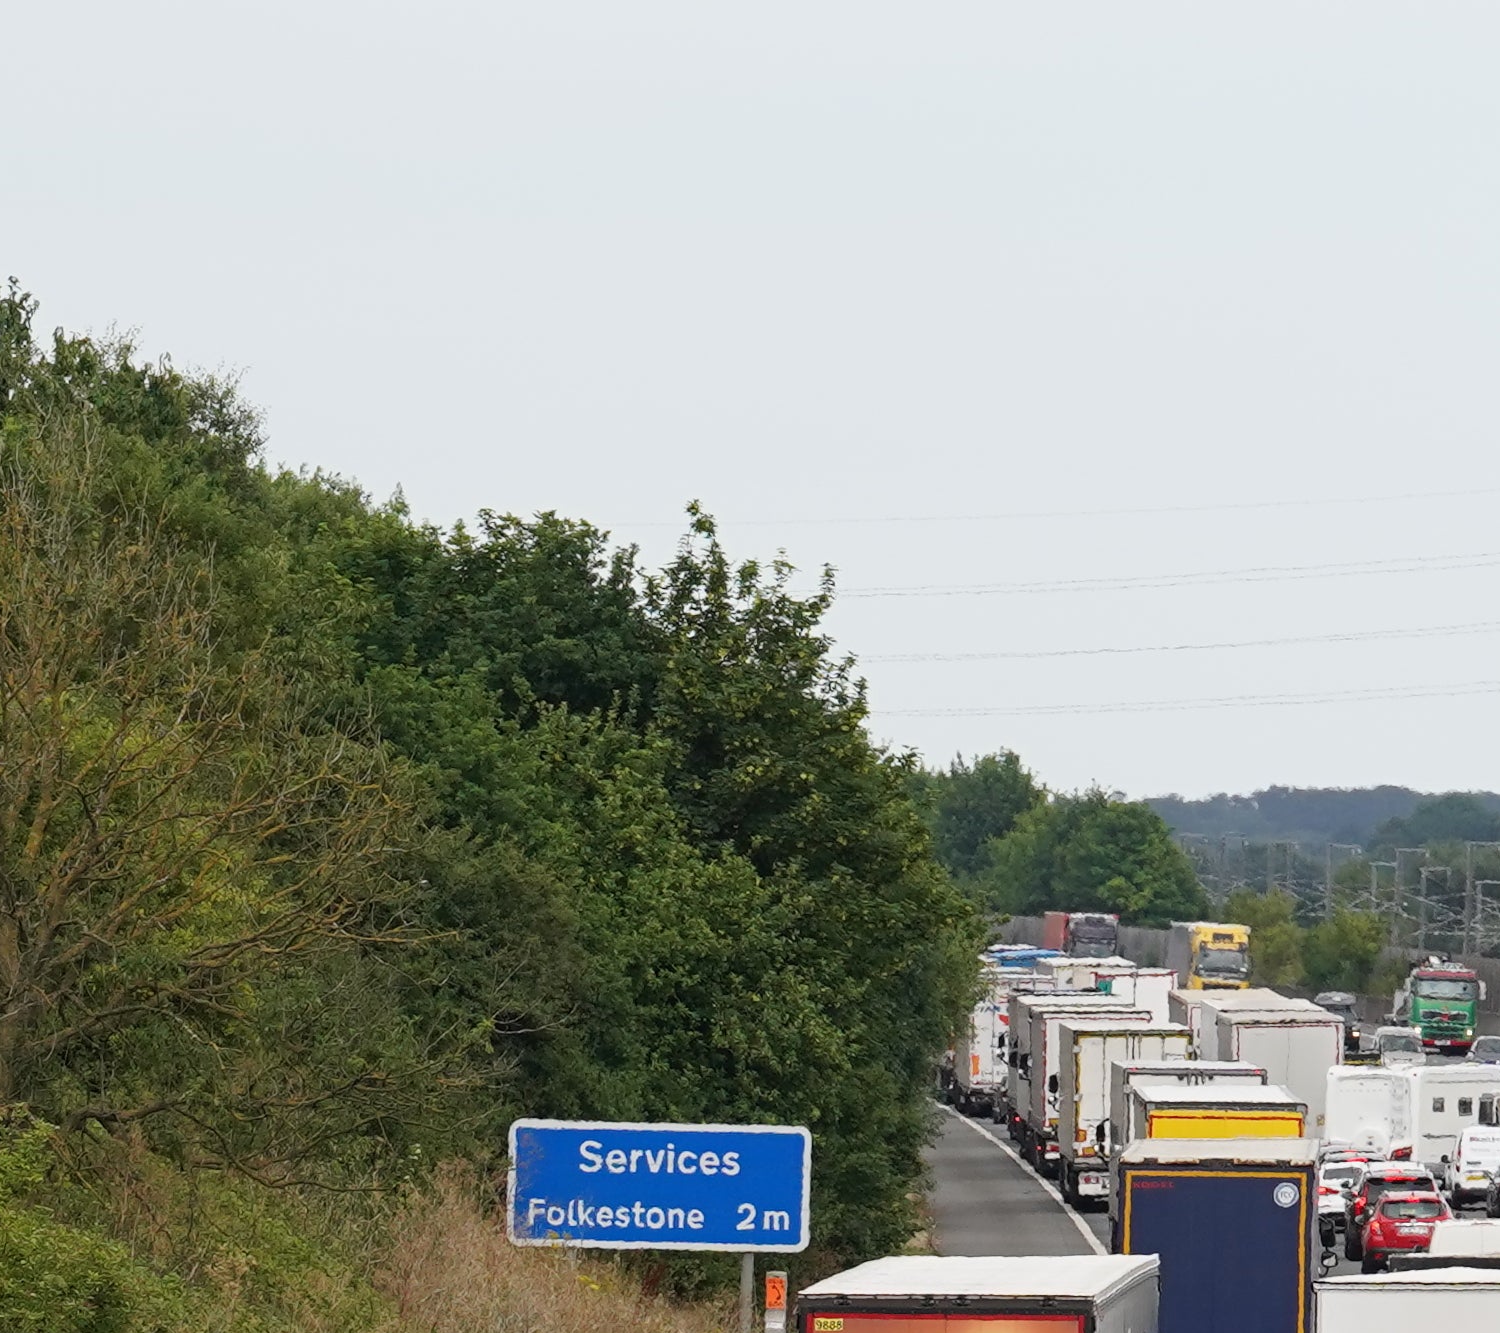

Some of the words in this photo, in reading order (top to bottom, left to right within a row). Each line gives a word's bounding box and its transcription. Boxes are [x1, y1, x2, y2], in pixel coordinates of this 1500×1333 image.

[579, 1140, 741, 1176] Services
[528, 1197, 705, 1229] Folkestone
[815, 1320, 843, 1330] 9888
